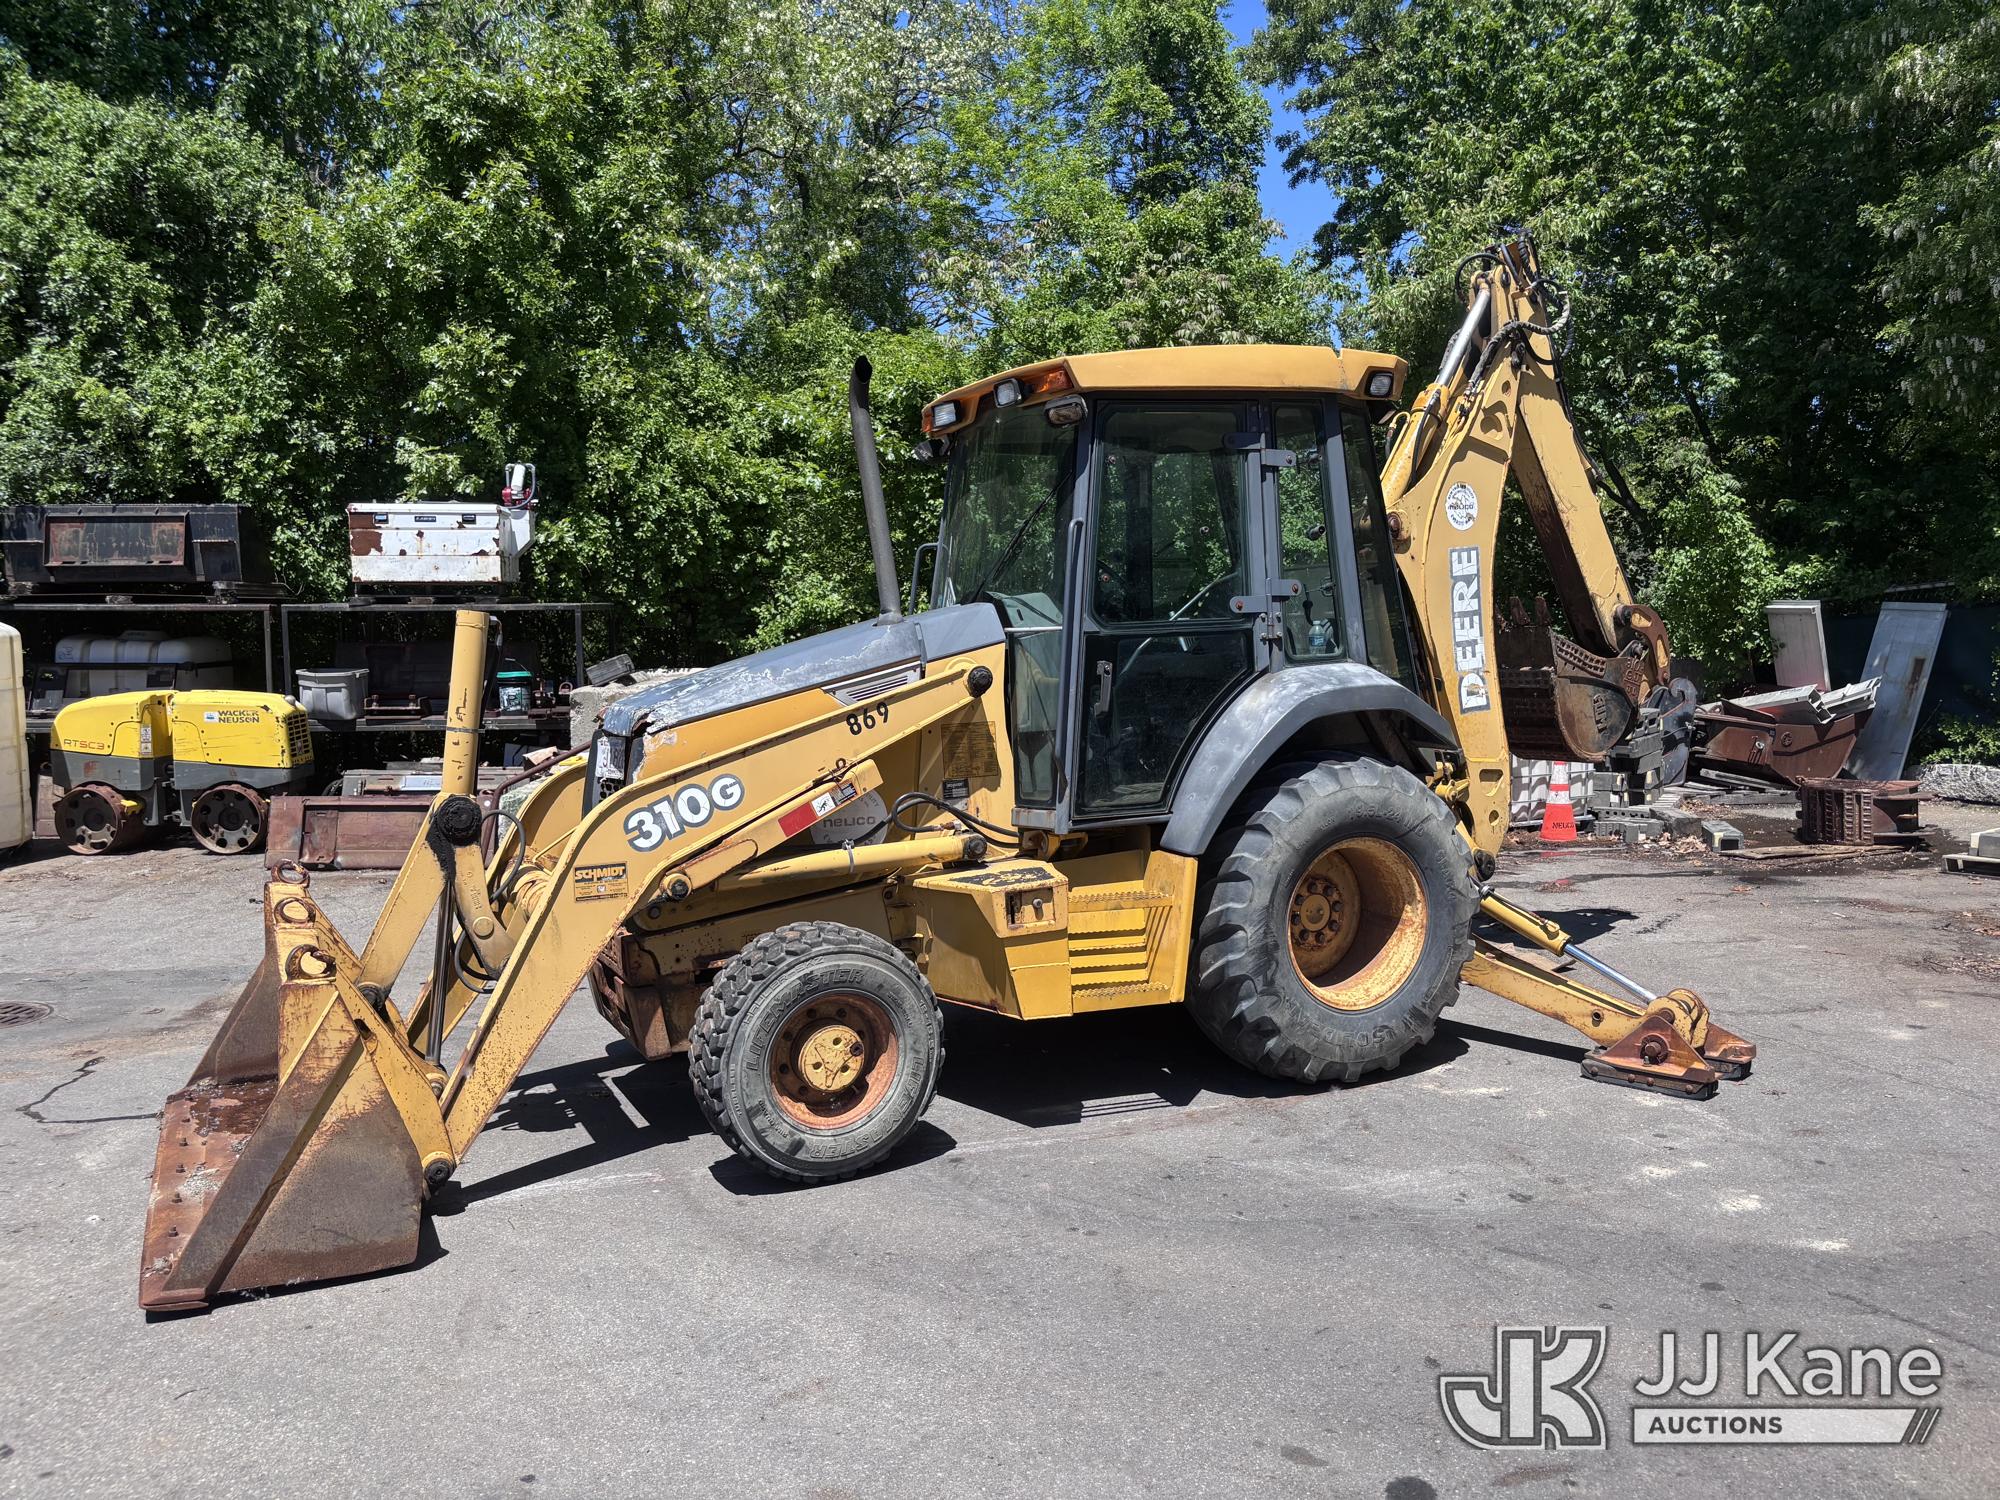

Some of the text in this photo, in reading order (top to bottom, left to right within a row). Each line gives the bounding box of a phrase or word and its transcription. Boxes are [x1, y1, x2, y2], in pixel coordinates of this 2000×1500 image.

[1451, 548, 1488, 710] DEERE
[218, 716, 260, 724] NEUSON
[846, 701, 889, 736] 869
[625, 774, 745, 852] 310G
[574, 865, 626, 882] SCHMIDT
[745, 967, 866, 1072] LIFEMASTER
